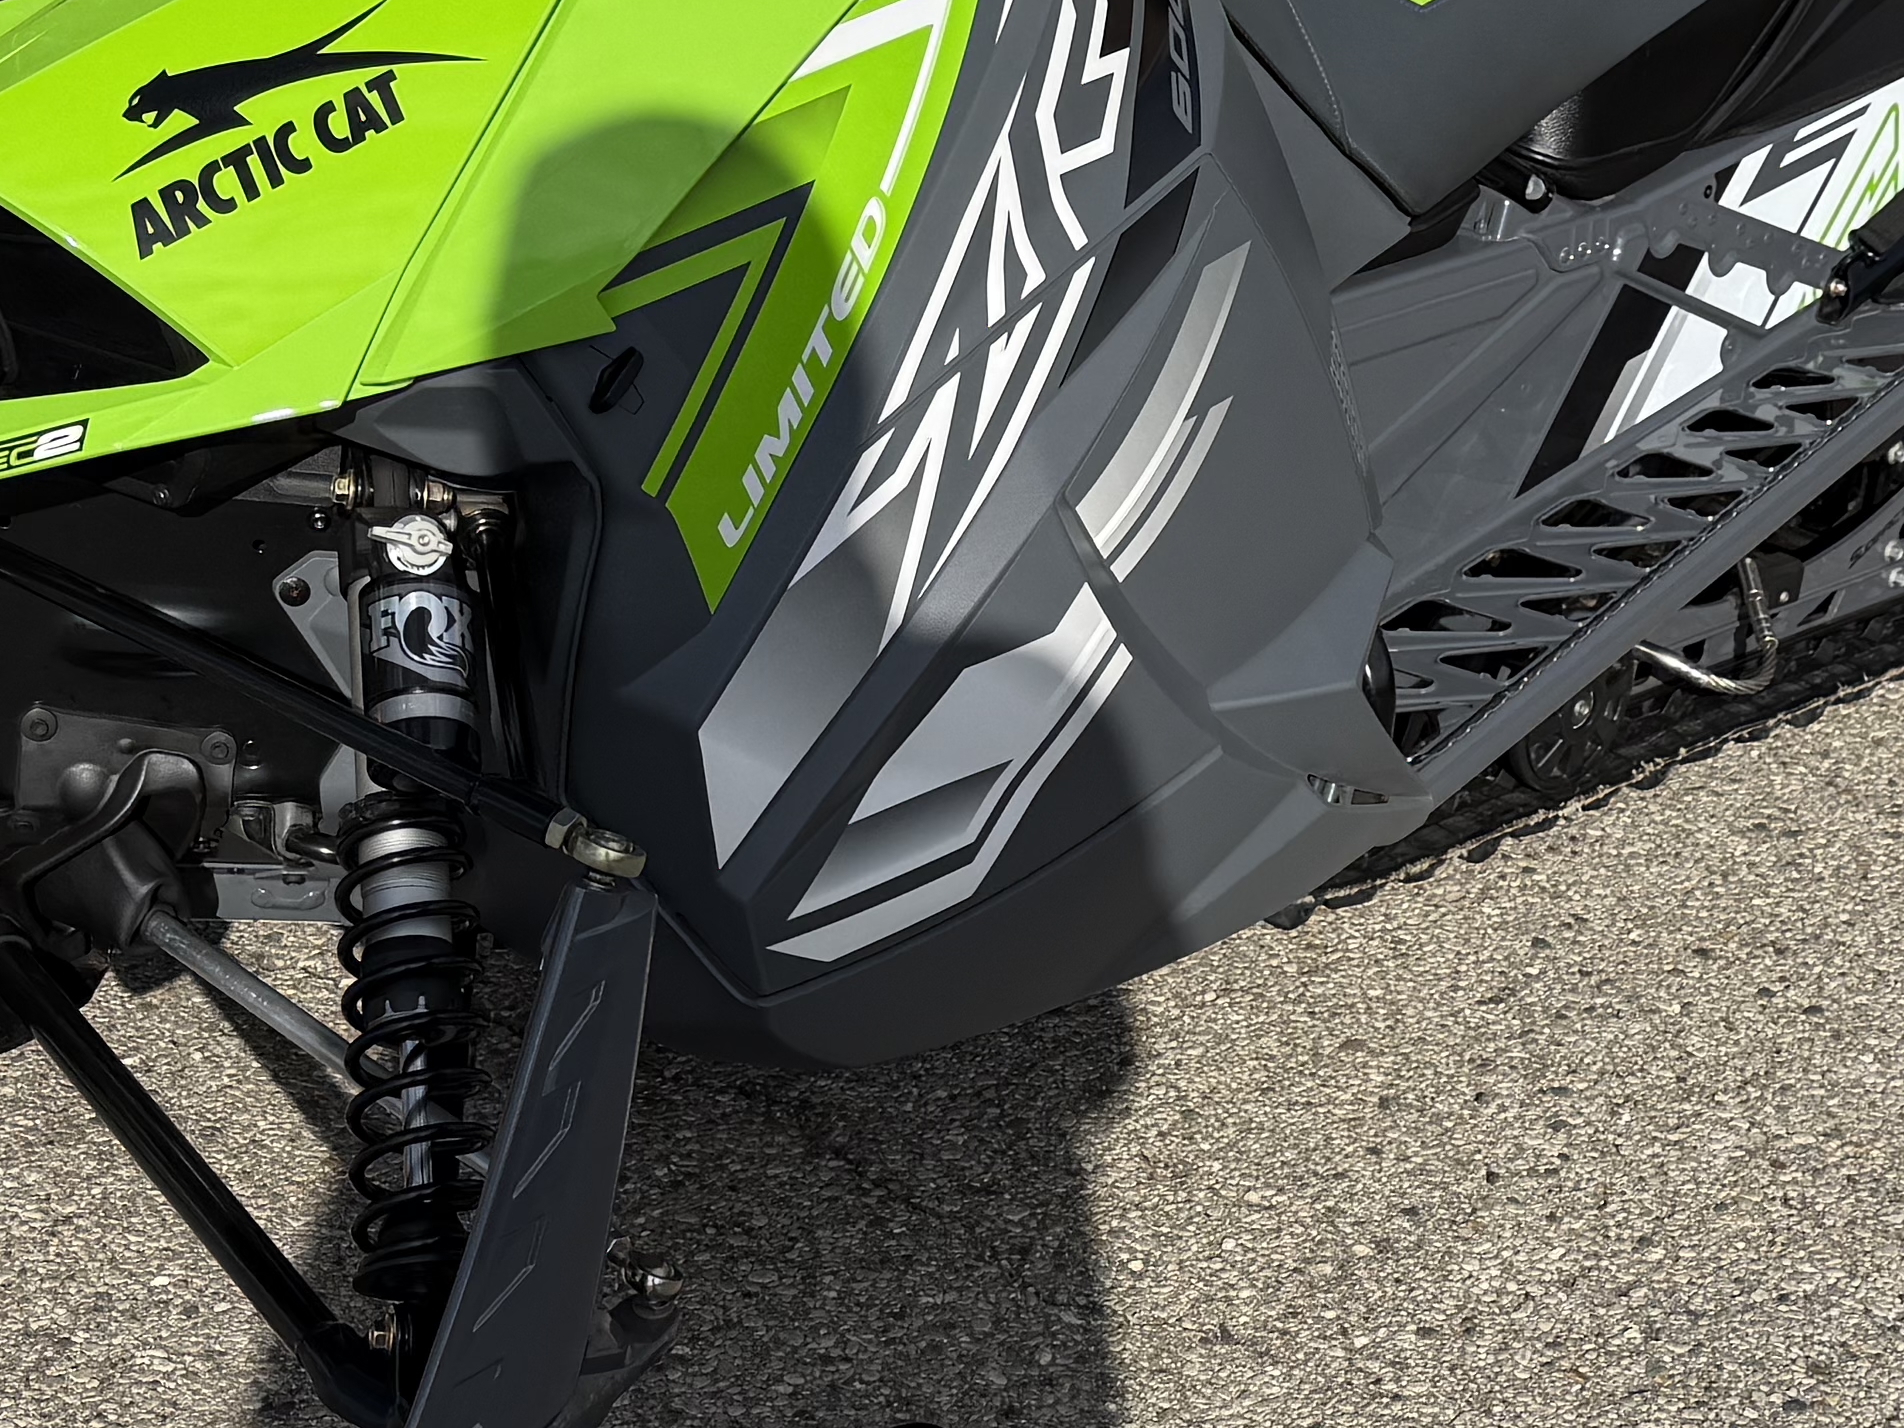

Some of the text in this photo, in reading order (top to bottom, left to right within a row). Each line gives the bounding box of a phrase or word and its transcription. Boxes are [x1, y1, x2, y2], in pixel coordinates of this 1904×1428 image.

[130, 68, 407, 260] ARCTIC CAT
[717, 196, 887, 549] LIMITED
[367, 590, 475, 674] FOX
